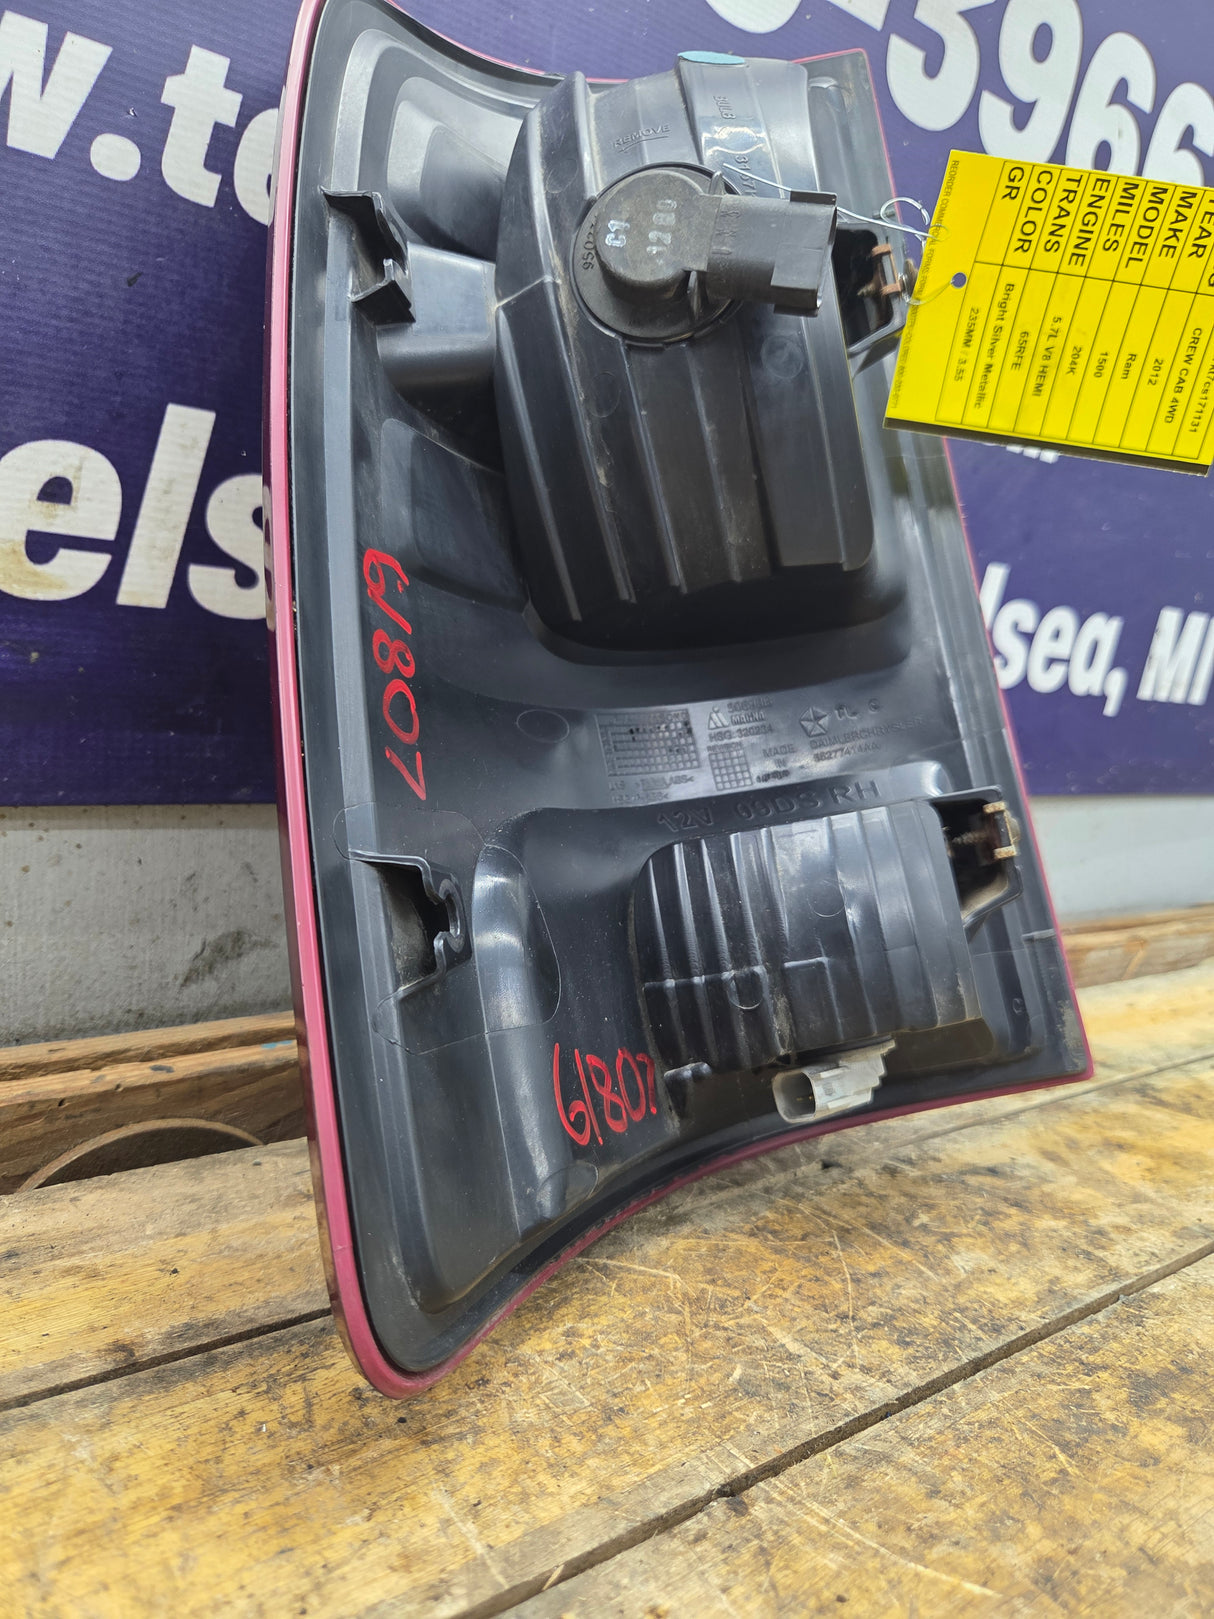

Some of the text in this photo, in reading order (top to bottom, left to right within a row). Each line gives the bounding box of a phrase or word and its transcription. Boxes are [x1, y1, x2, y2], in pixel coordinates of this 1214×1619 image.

[613, 124, 671, 148] REMOVE
[1002, 166, 1025, 201] GR
[1014, 169, 1054, 254] COLOR
[1044, 174, 1084, 254] TRANS
[1067, 177, 1112, 267] ENGINE
[1102, 182, 1140, 252] MILES
[1125, 186, 1168, 268] MODEL
[1158, 191, 1198, 259] MAKE
[961, 306, 979, 348] 235MM
[973, 281, 1015, 410] Bright Silver Metallic
[1010, 330, 1029, 372] 65RFE
[1031, 315, 1062, 397] 5.7L V8 HEMI
[1065, 345, 1082, 376] 204K
[1093, 350, 1108, 378] 1500
[1121, 352, 1136, 380] Ram
[1147, 357, 1163, 386] 2012
[1164, 327, 1202, 424] CREW CAB 4WD
[1136, 606, 1214, 705] MI
[762, 744, 795, 758] MADE
[656, 802, 714, 834] 12V
[828, 778, 881, 806] RH
